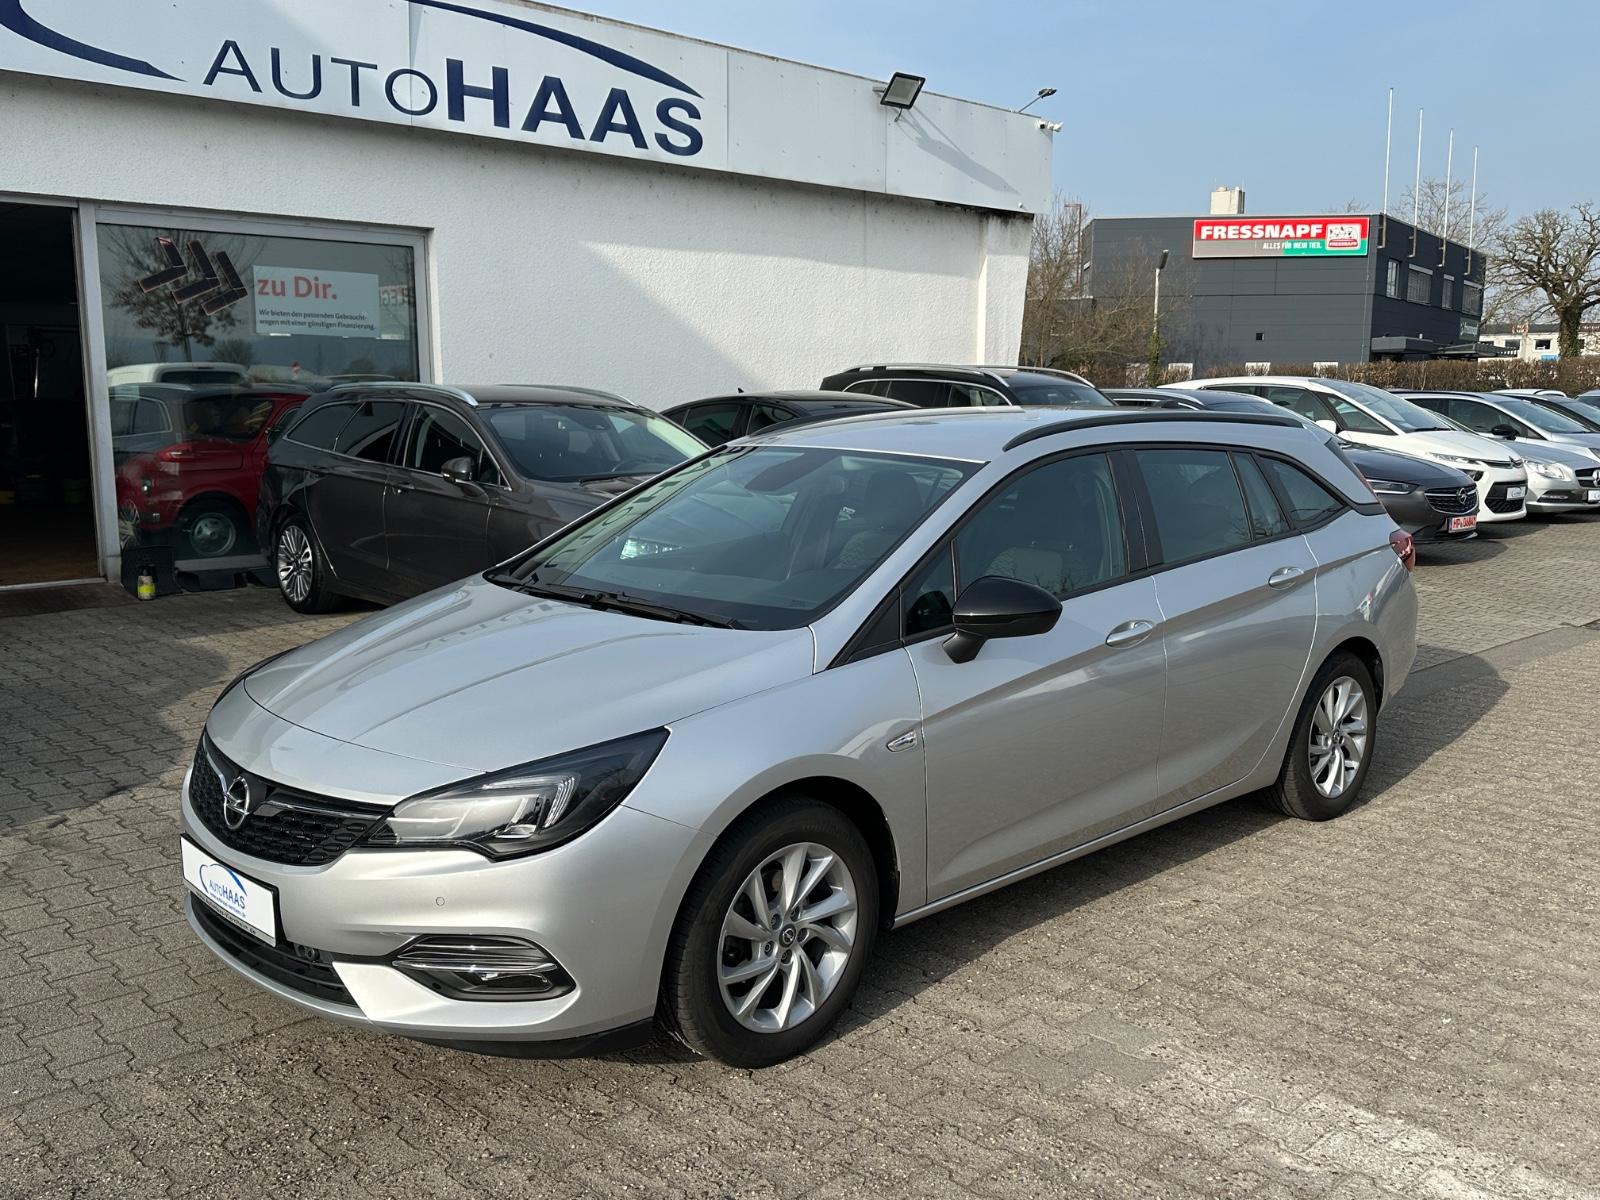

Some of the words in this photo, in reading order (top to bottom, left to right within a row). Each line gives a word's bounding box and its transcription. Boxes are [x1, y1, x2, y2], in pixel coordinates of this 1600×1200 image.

[1201, 224, 1322, 239] FRESSNAPF
[257, 278, 286, 297] zu
[294, 276, 337, 300] Dir.
[271, 310, 291, 318] bieten
[304, 312, 334, 321] passenden
[335, 313, 367, 321] Gebraucht-
[260, 319, 279, 327] wagen
[308, 320, 337, 330] günstigen
[337, 321, 376, 331] Finanzierung.
